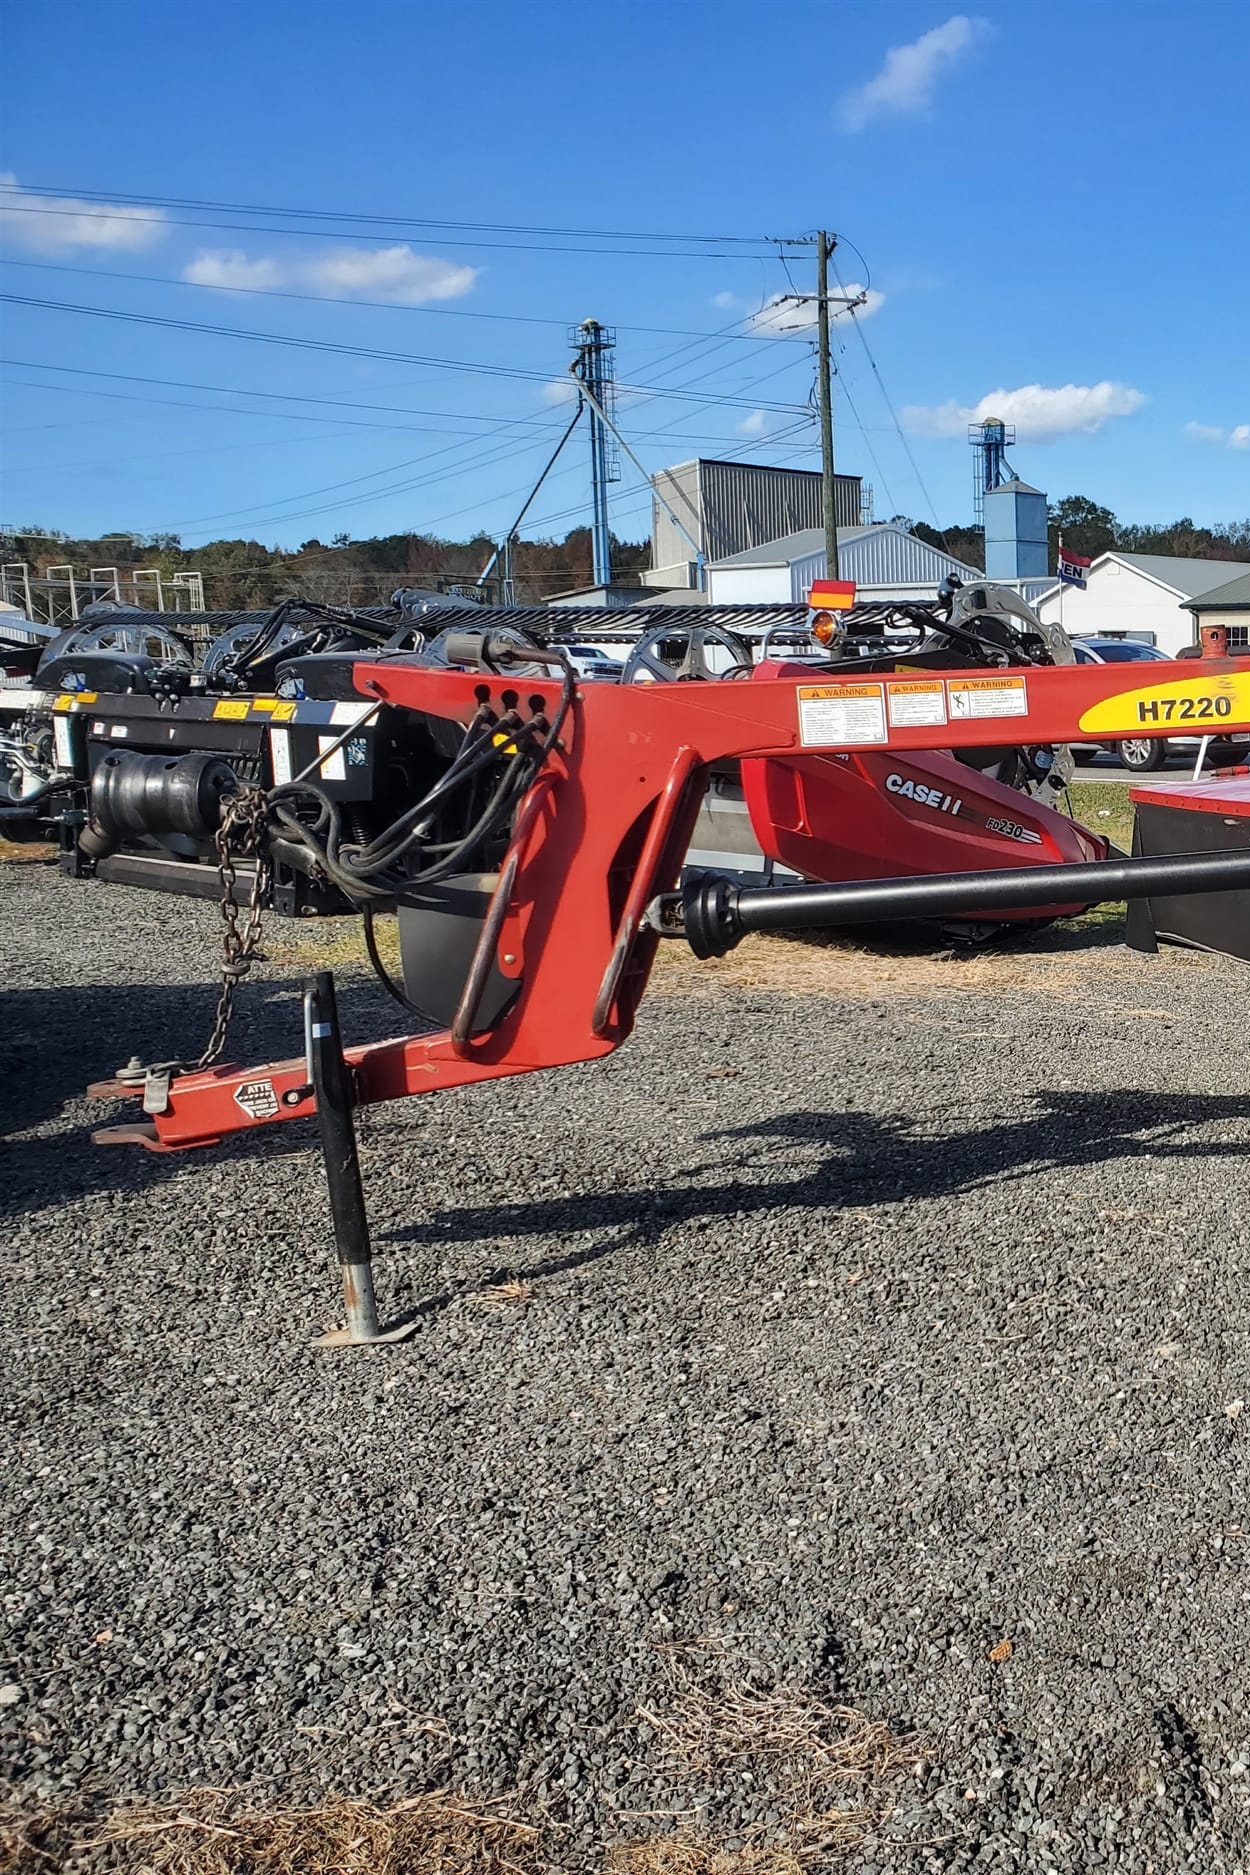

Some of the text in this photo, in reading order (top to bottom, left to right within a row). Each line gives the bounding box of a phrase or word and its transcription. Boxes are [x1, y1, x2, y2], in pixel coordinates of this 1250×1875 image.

[824, 687, 868, 697] WARNING
[902, 684, 937, 692] WARNING
[971, 680, 1013, 689] WARNING
[1138, 696, 1232, 722] H7220
[885, 774, 941, 809] CASE
[985, 817, 1024, 840] FD230
